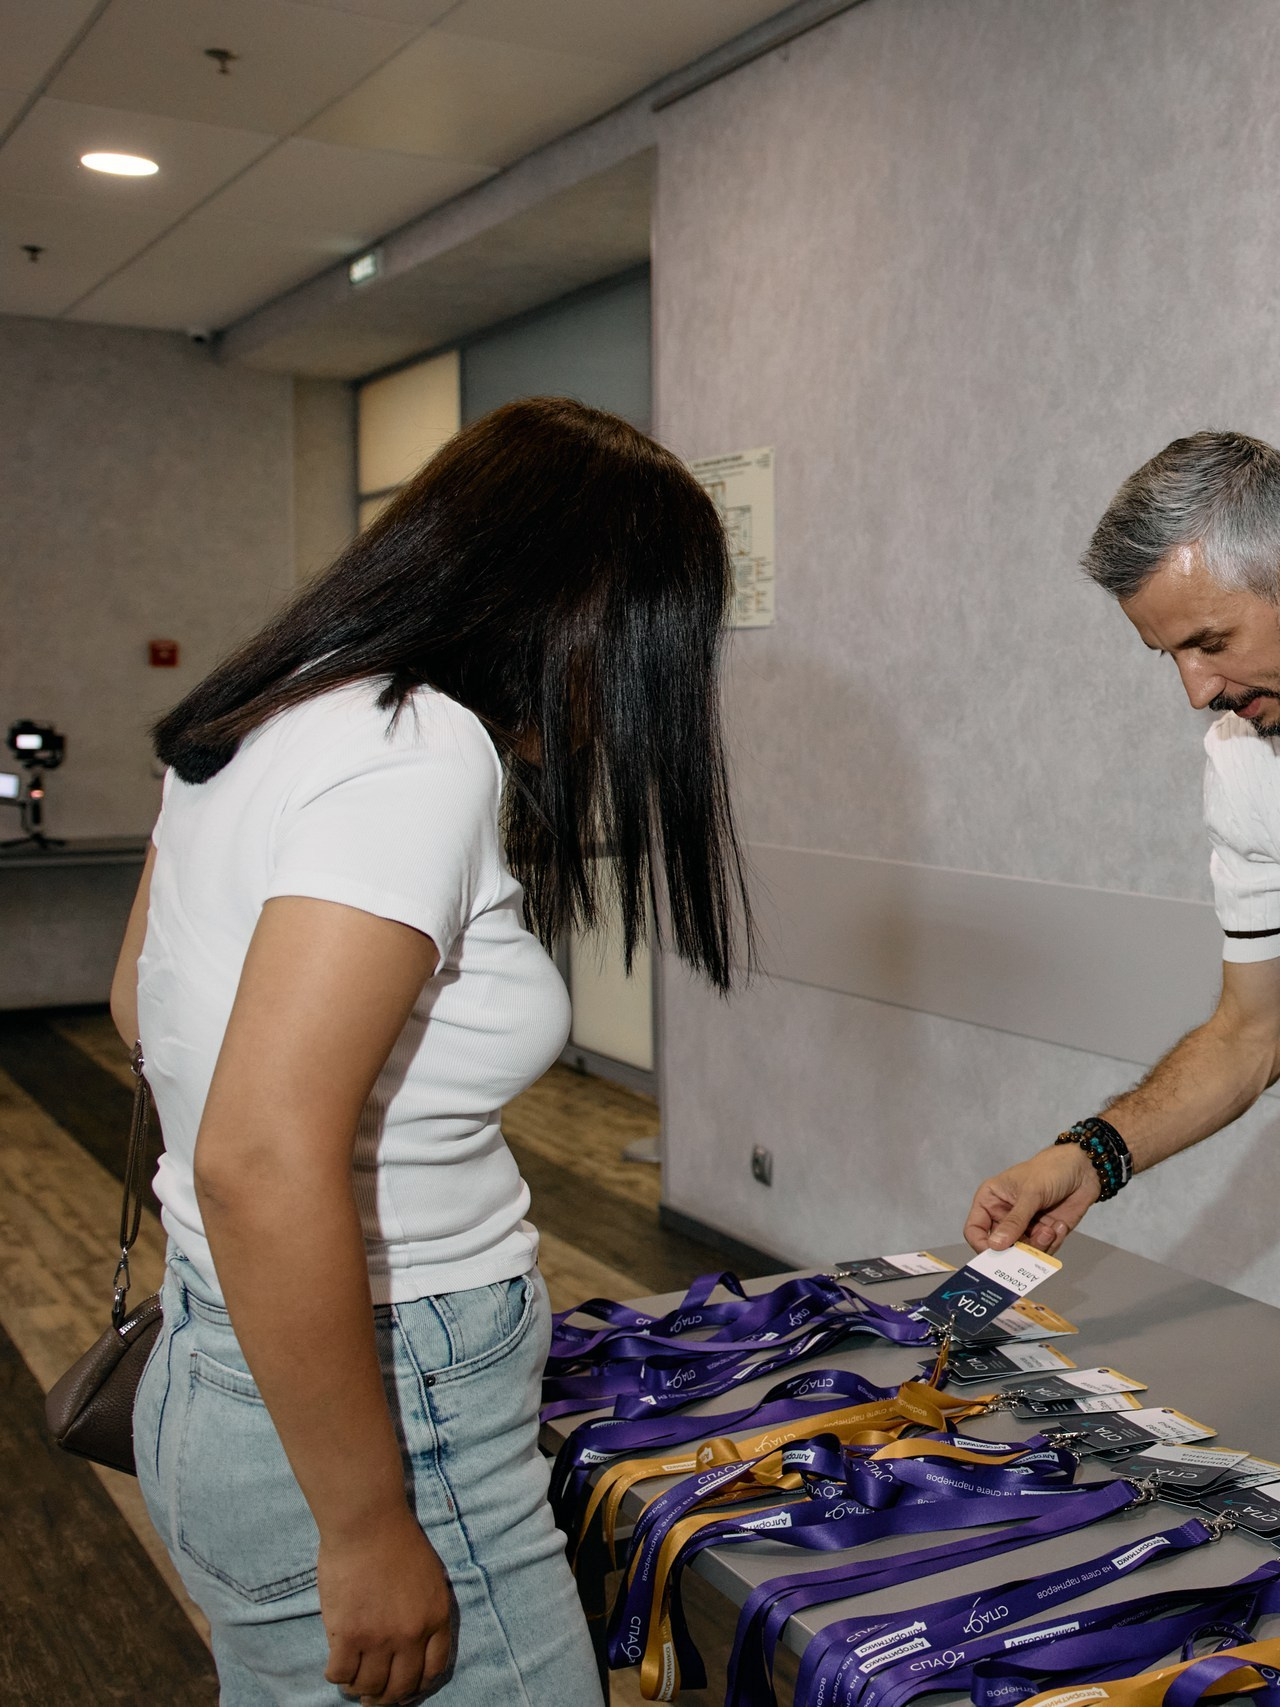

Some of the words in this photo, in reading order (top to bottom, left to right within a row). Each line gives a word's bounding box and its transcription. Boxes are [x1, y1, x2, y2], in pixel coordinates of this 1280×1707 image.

[994, 1269, 1028, 1292] Скокова
[1017, 1267, 1039, 1283] Алла
[957, 1295, 987, 1318] СПА
[966, 1357, 988, 1371] СПА
[809, 1377, 834, 1388] СПА
[1094, 1426, 1123, 1442] СПА
[1181, 1453, 1236, 1463] Светлана
[697, 1470, 725, 1485] СПА
[1155, 1467, 1198, 1480] СПА
[926, 1473, 975, 1492] партнеров
[682, 1496, 693, 1505] на
[661, 1505, 682, 1528] слете
[1242, 1506, 1278, 1522] СПА
[642, 1529, 662, 1582] партнеров
[1116, 1538, 1166, 1566] Алгоритмика
[1081, 1569, 1102, 1582] слете
[1101, 1564, 1113, 1573] на
[1036, 1577, 1081, 1599] партнеров
[980, 1604, 1009, 1624] СПА
[627, 1615, 642, 1644] СПА
[846, 1624, 877, 1643] СПА
[859, 1626, 923, 1654] Алгоритмика
[864, 1640, 925, 1670] Алгоритмика
[842, 1657, 854, 1670] на
[910, 1658, 944, 1671] СПА
[833, 1672, 843, 1704] слете
[850, 1675, 860, 1689] на
